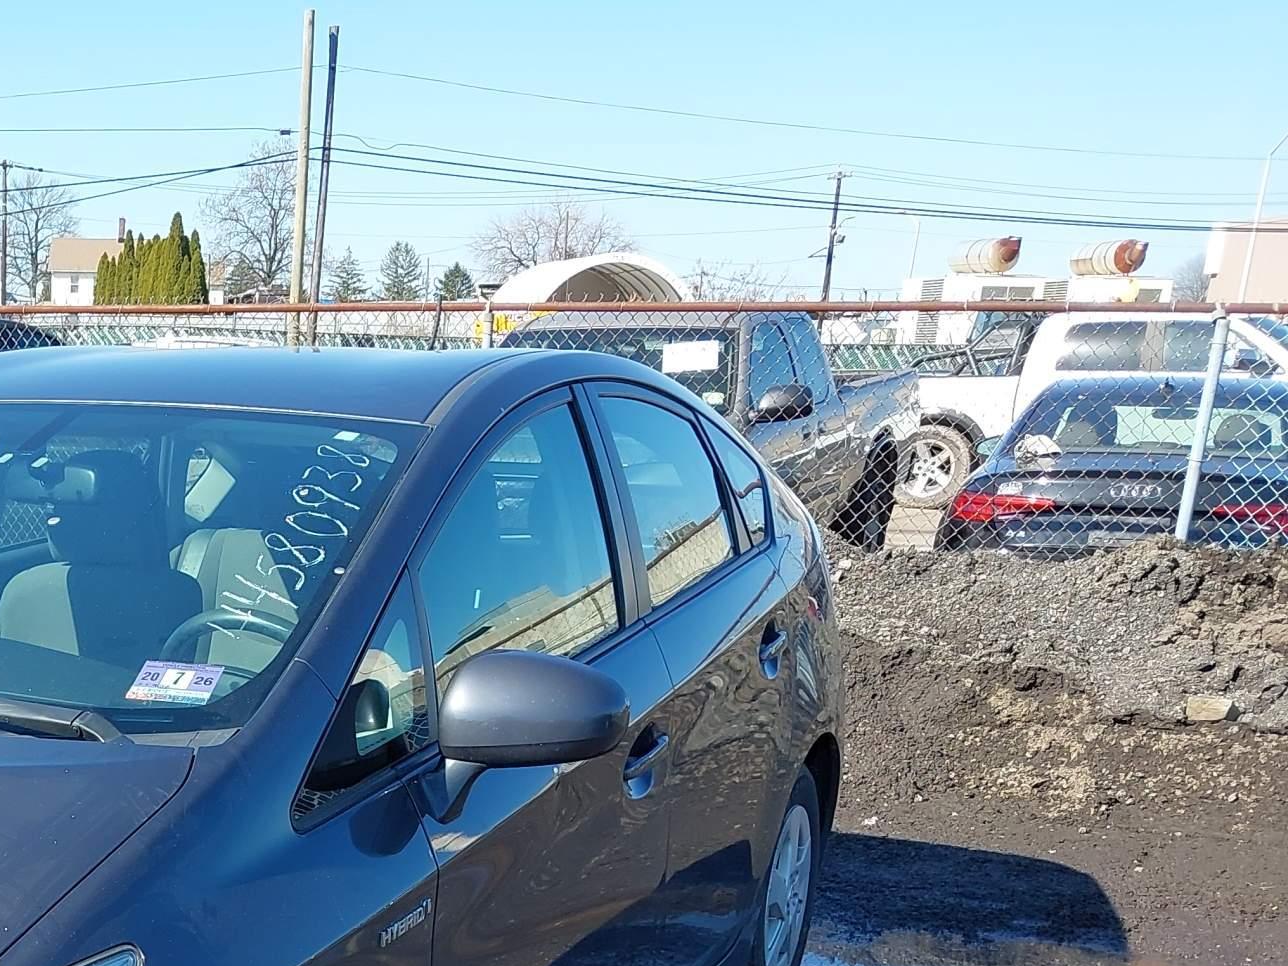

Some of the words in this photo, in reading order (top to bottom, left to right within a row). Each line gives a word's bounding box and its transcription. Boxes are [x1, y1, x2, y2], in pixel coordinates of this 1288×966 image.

[207, 445, 369, 639] 44580938
[141, 671, 160, 682] 20
[172, 672, 186, 685] 7
[193, 676, 214, 687] 26
[380, 900, 431, 948] HYBRID
